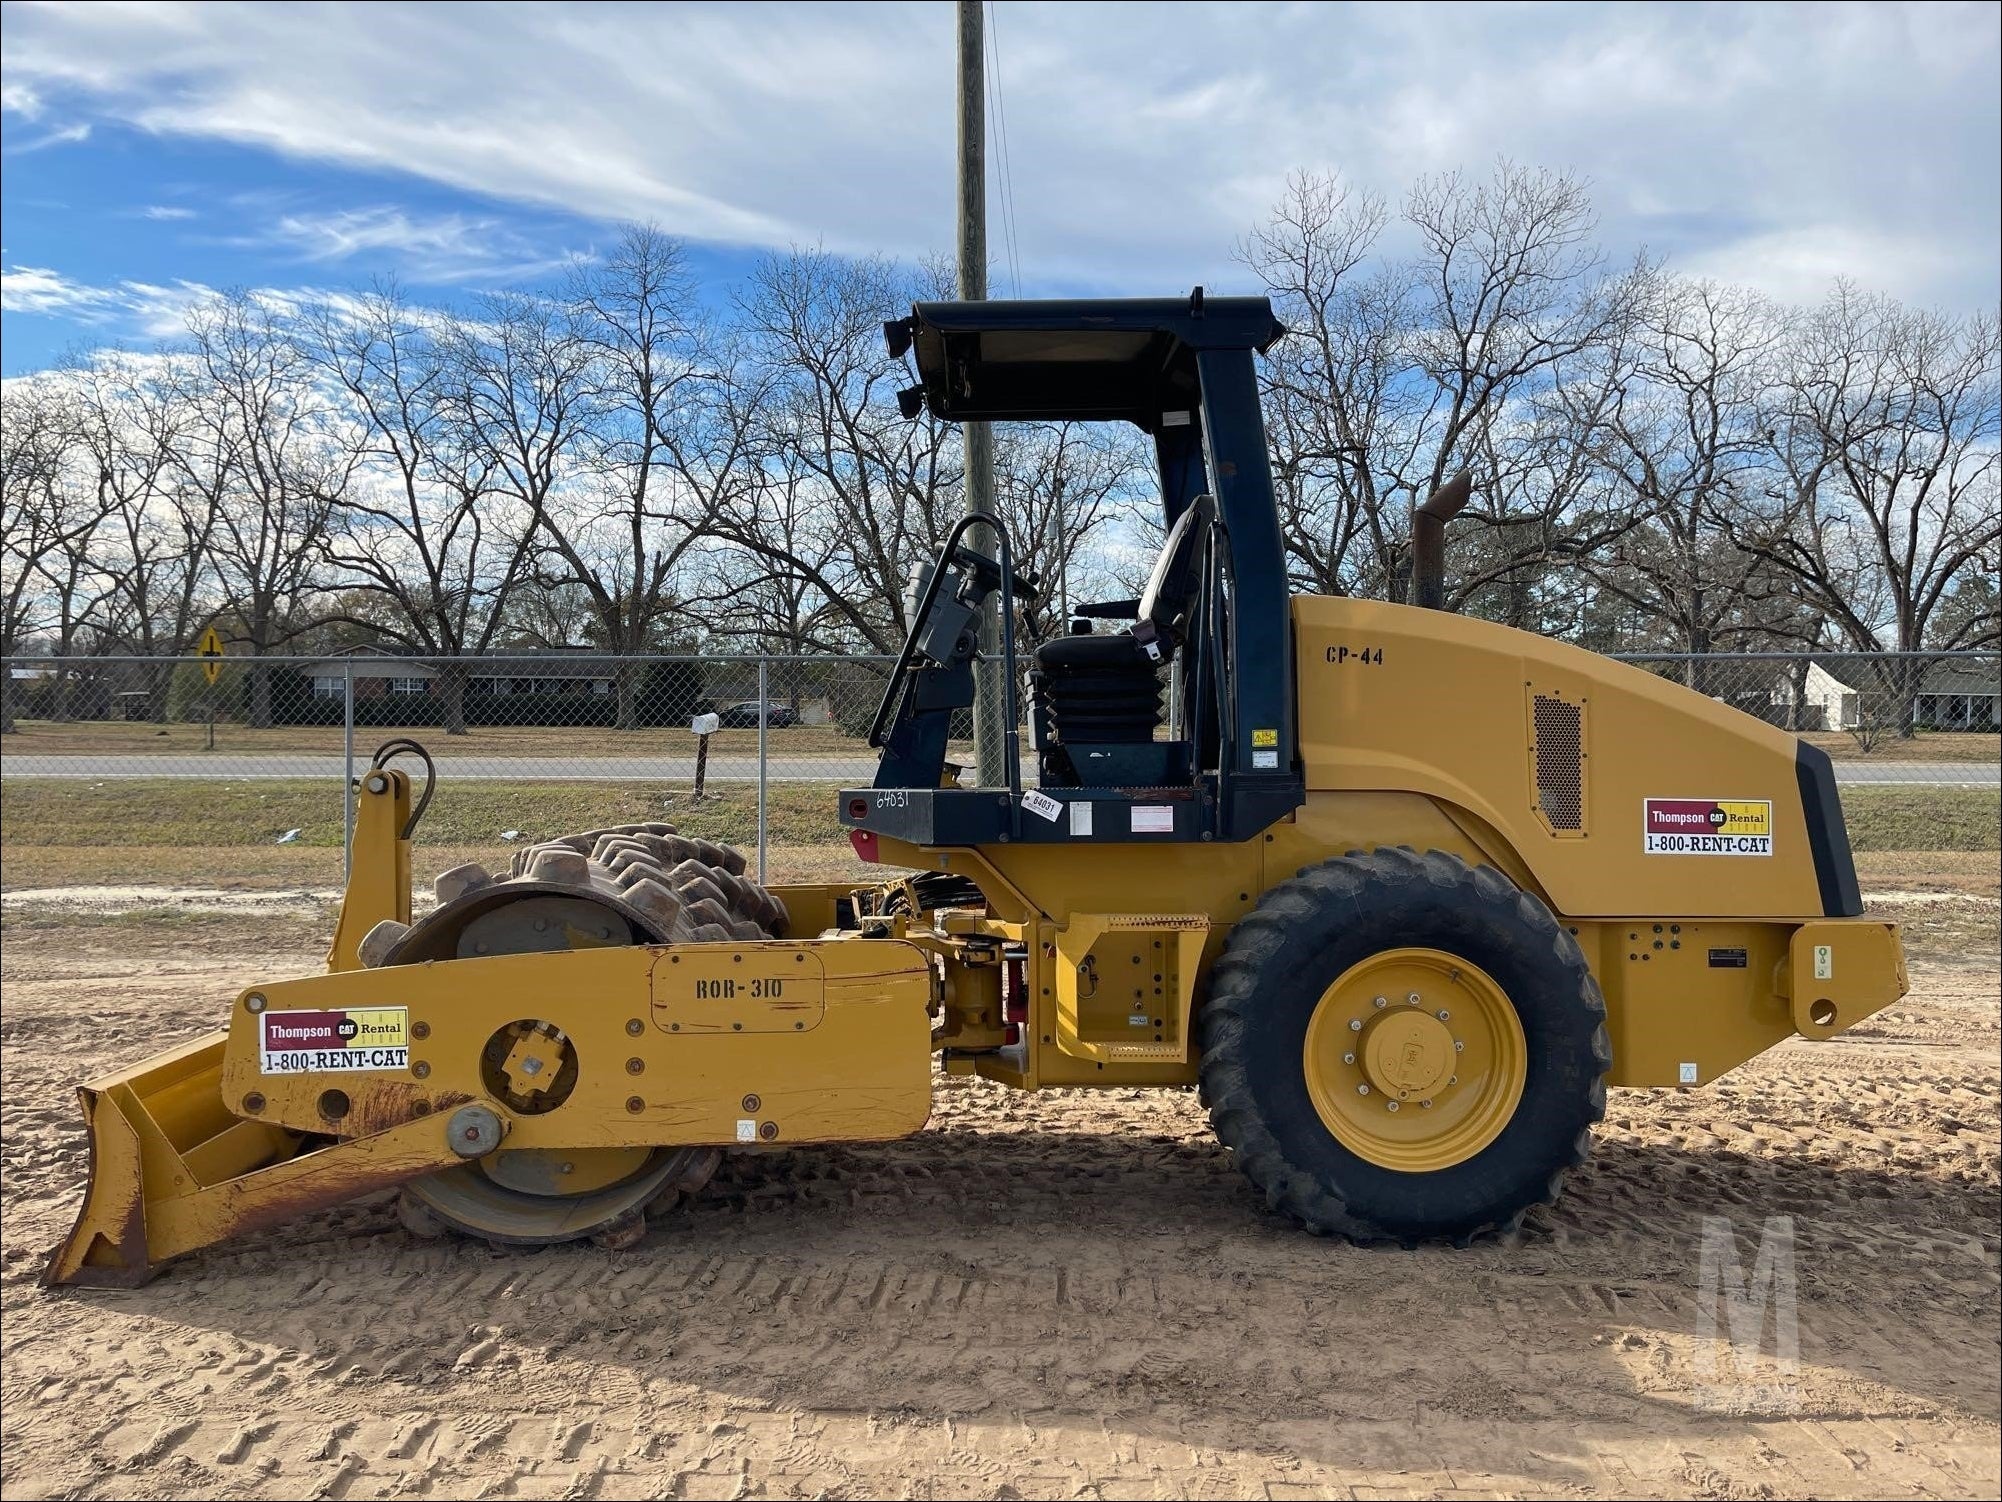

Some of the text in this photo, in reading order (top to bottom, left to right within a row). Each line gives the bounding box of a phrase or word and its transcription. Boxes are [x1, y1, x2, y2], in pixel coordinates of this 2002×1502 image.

[1326, 646, 1383, 666] CP-44
[876, 791, 910, 809] 64031
[1033, 796, 1055, 813] 64031
[1652, 810, 1765, 826] Thompson CAT Rental
[1647, 835, 1770, 853] 1-800-RENT-CAT
[696, 979, 782, 999] ROR-310
[270, 1023, 401, 1041] Thompson CAT Rental
[266, 1049, 407, 1071] 1-800-RENT-CAT
